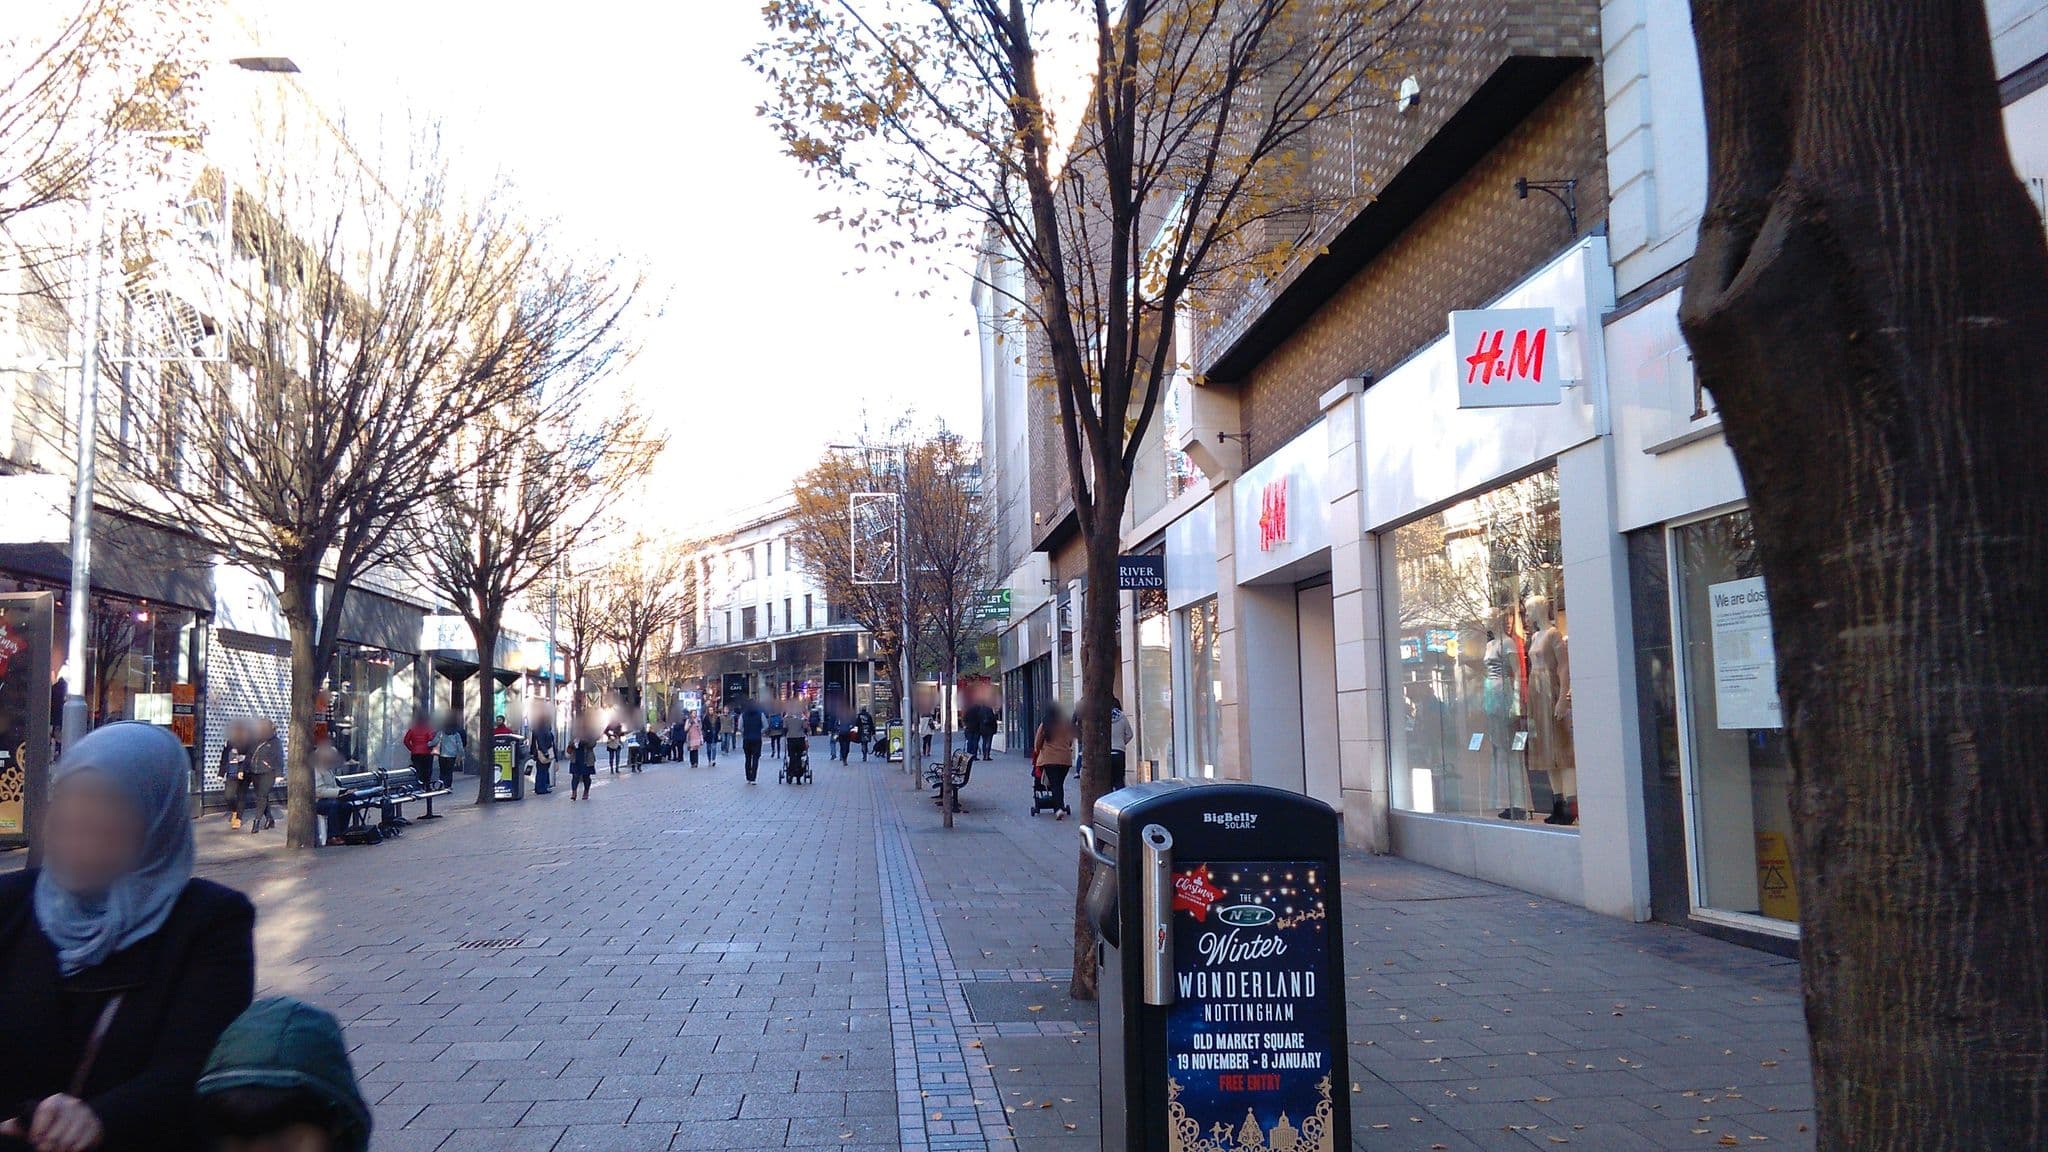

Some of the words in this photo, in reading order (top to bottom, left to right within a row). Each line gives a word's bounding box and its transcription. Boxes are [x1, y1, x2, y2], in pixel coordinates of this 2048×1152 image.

[1465, 326, 1547, 386] H&M
[1120, 566, 1154, 576] RIVER
[1120, 577, 1163, 587] ISLAND
[1715, 593, 1731, 608] We
[1731, 595, 1745, 606] are
[1203, 812, 1258, 825] BigBelly
[1240, 893, 1252, 903] THE
[1228, 910, 1267, 921] NET
[1198, 928, 1287, 966] Winter
[1178, 971, 1316, 999] WONDERLAND
[1204, 1003, 1294, 1022] NOTTINGHAM
[1193, 1033, 1214, 1050] OLD
[1216, 1033, 1260, 1050] MARKET
[1263, 1032, 1305, 1050] SQUARE
[1177, 1054, 1189, 1070] 19
[1191, 1053, 1250, 1070] NOVEMBER
[1261, 1053, 1268, 1069] 8
[1270, 1052, 1322, 1069] JANUARY
[1219, 1074, 1247, 1091] FREE
[1249, 1074, 1281, 1091] ENTRY
